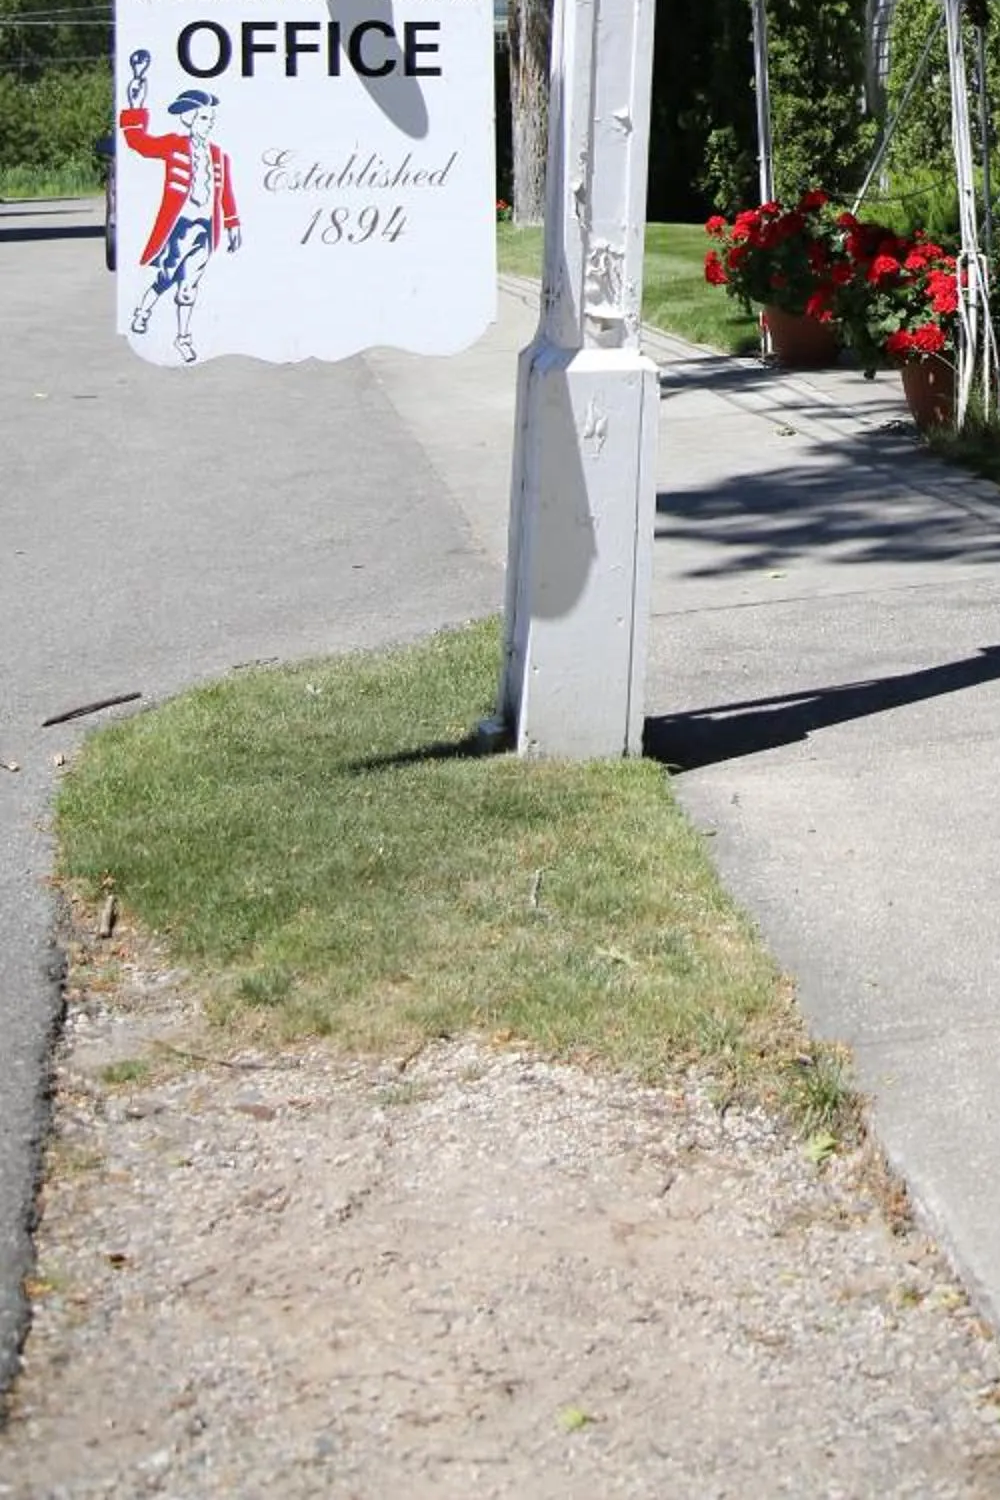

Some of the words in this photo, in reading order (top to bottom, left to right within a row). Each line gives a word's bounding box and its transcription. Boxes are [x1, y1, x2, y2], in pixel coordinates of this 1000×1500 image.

[176, 20, 442, 78] OFFICE
[261, 146, 459, 192] Established
[300, 205, 409, 246] 1894
